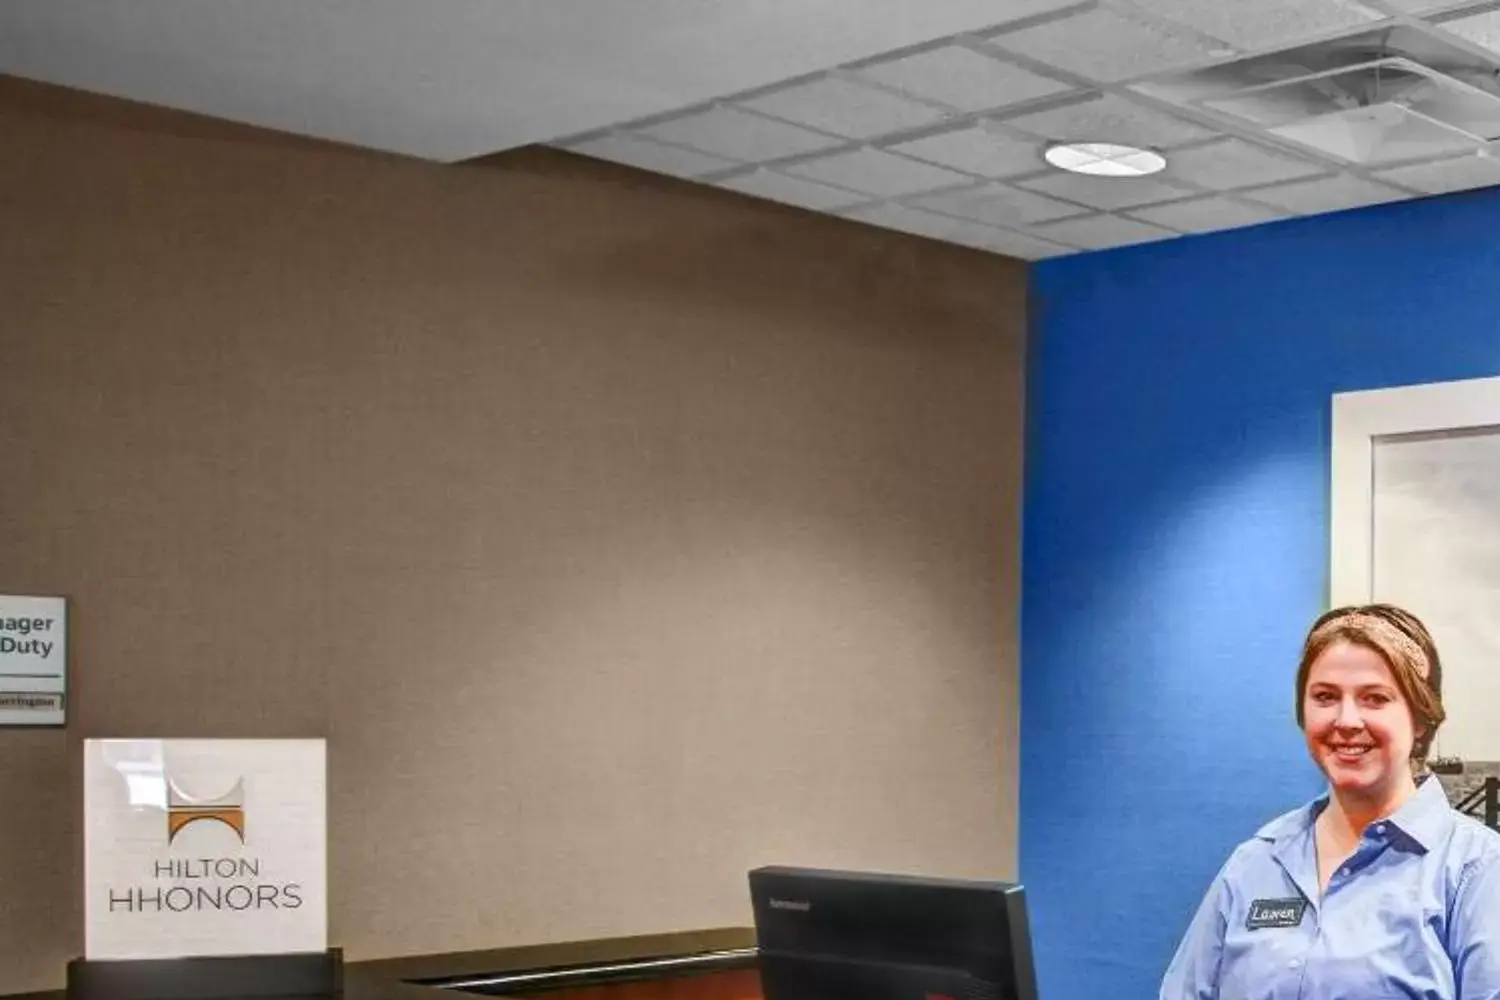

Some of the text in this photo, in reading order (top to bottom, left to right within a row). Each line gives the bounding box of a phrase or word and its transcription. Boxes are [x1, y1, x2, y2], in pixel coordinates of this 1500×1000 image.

[0, 616, 54, 634] ager
[1, 637, 53, 658] Duty
[154, 858, 260, 878] HILTON
[109, 884, 303, 912] HHONORS
